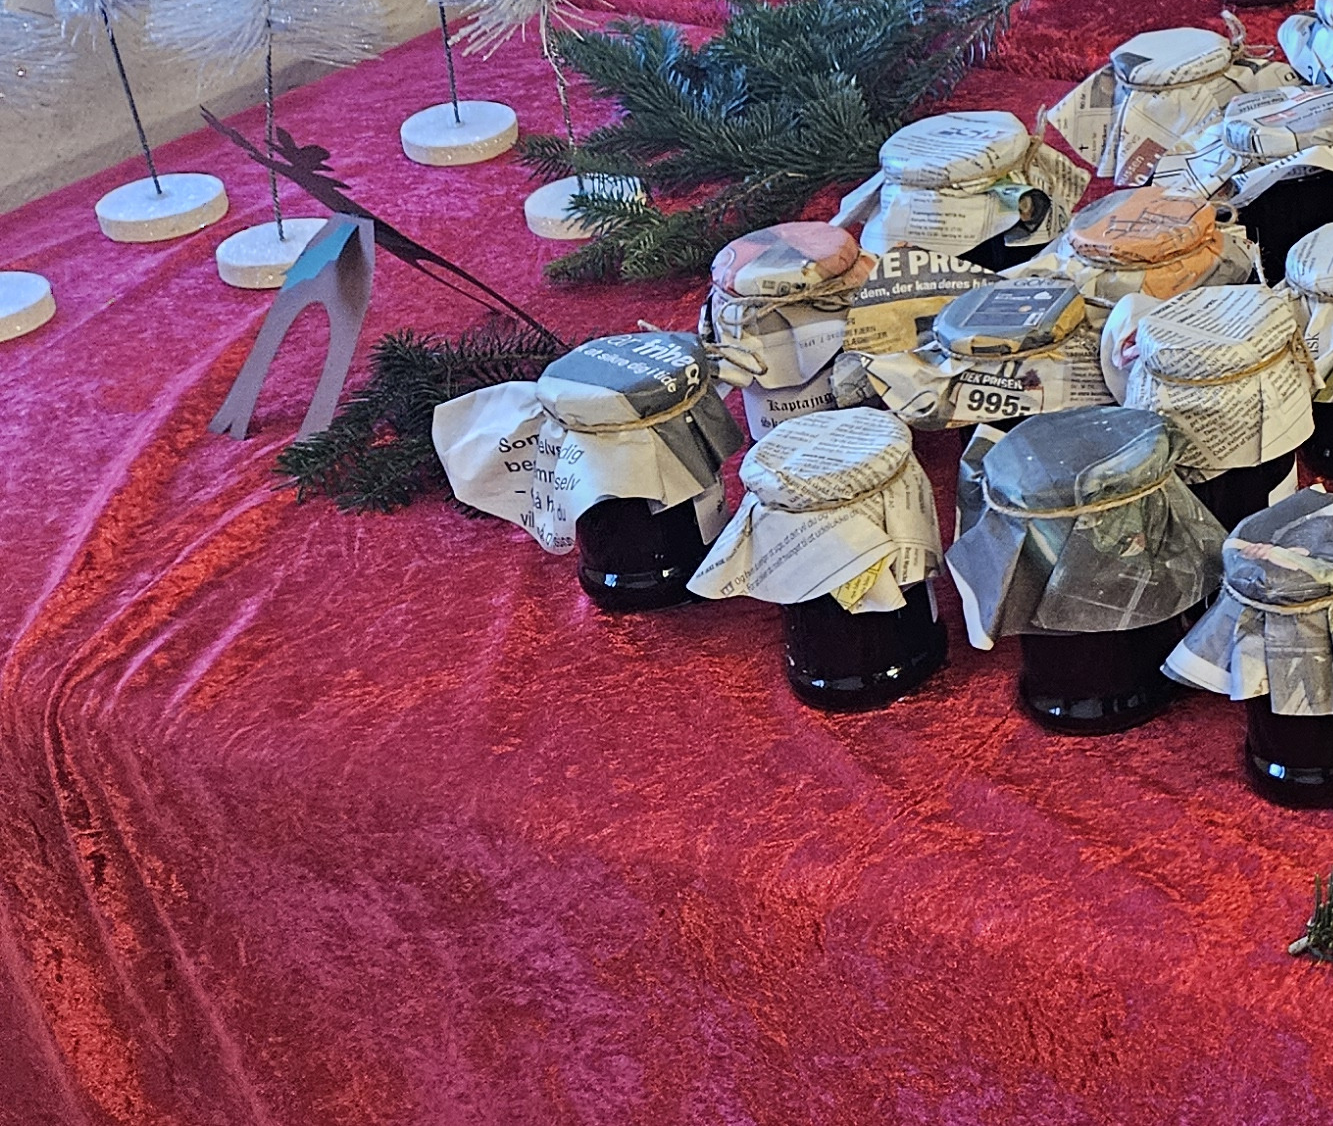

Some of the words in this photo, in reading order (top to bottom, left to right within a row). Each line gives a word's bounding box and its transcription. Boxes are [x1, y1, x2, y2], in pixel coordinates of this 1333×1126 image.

[860, 287, 890, 299] dem,
[892, 281, 914, 295] der
[915, 279, 937, 291] kan
[938, 279, 970, 291] deres
[981, 374, 1024, 391] PRISEN
